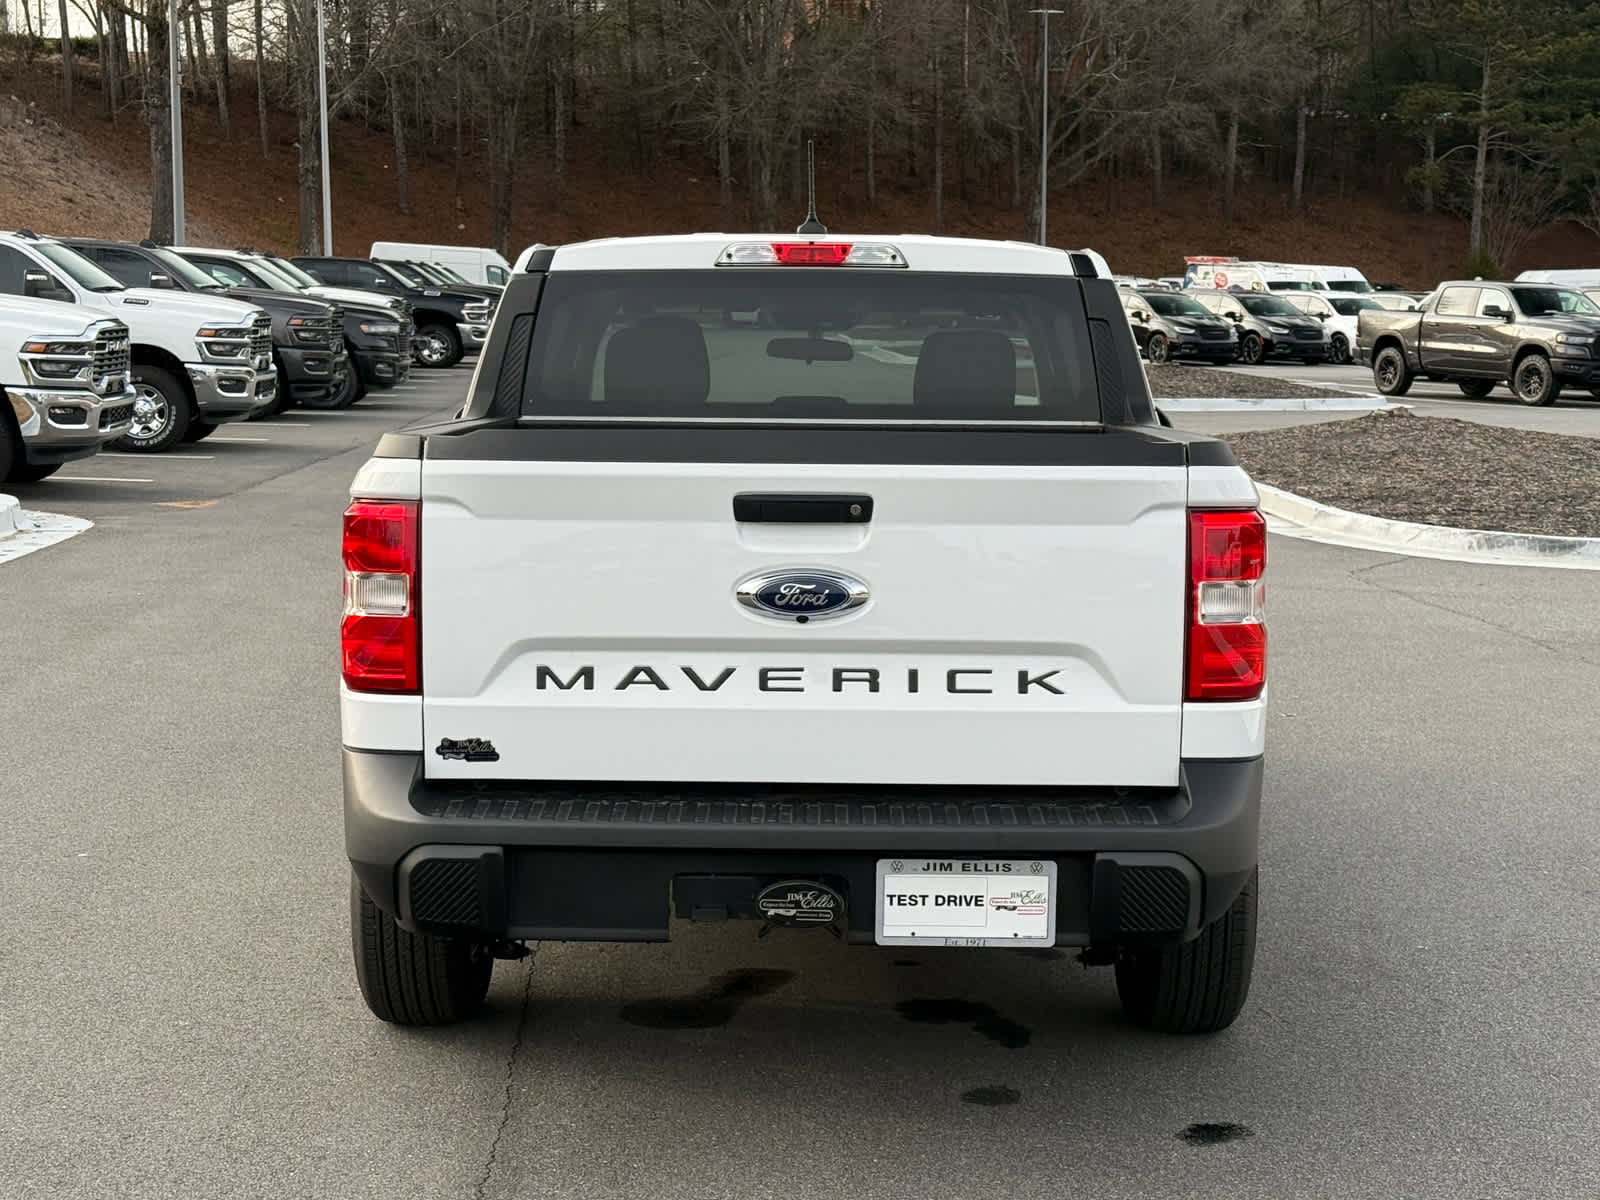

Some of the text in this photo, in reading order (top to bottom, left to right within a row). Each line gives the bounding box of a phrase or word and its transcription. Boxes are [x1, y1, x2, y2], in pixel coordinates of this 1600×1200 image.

[775, 583, 830, 606] Ford
[536, 665, 1066, 694] MAVERICK
[922, 863, 1012, 873] JIM ELLIS
[887, 894, 985, 907] TEST DRIVE
